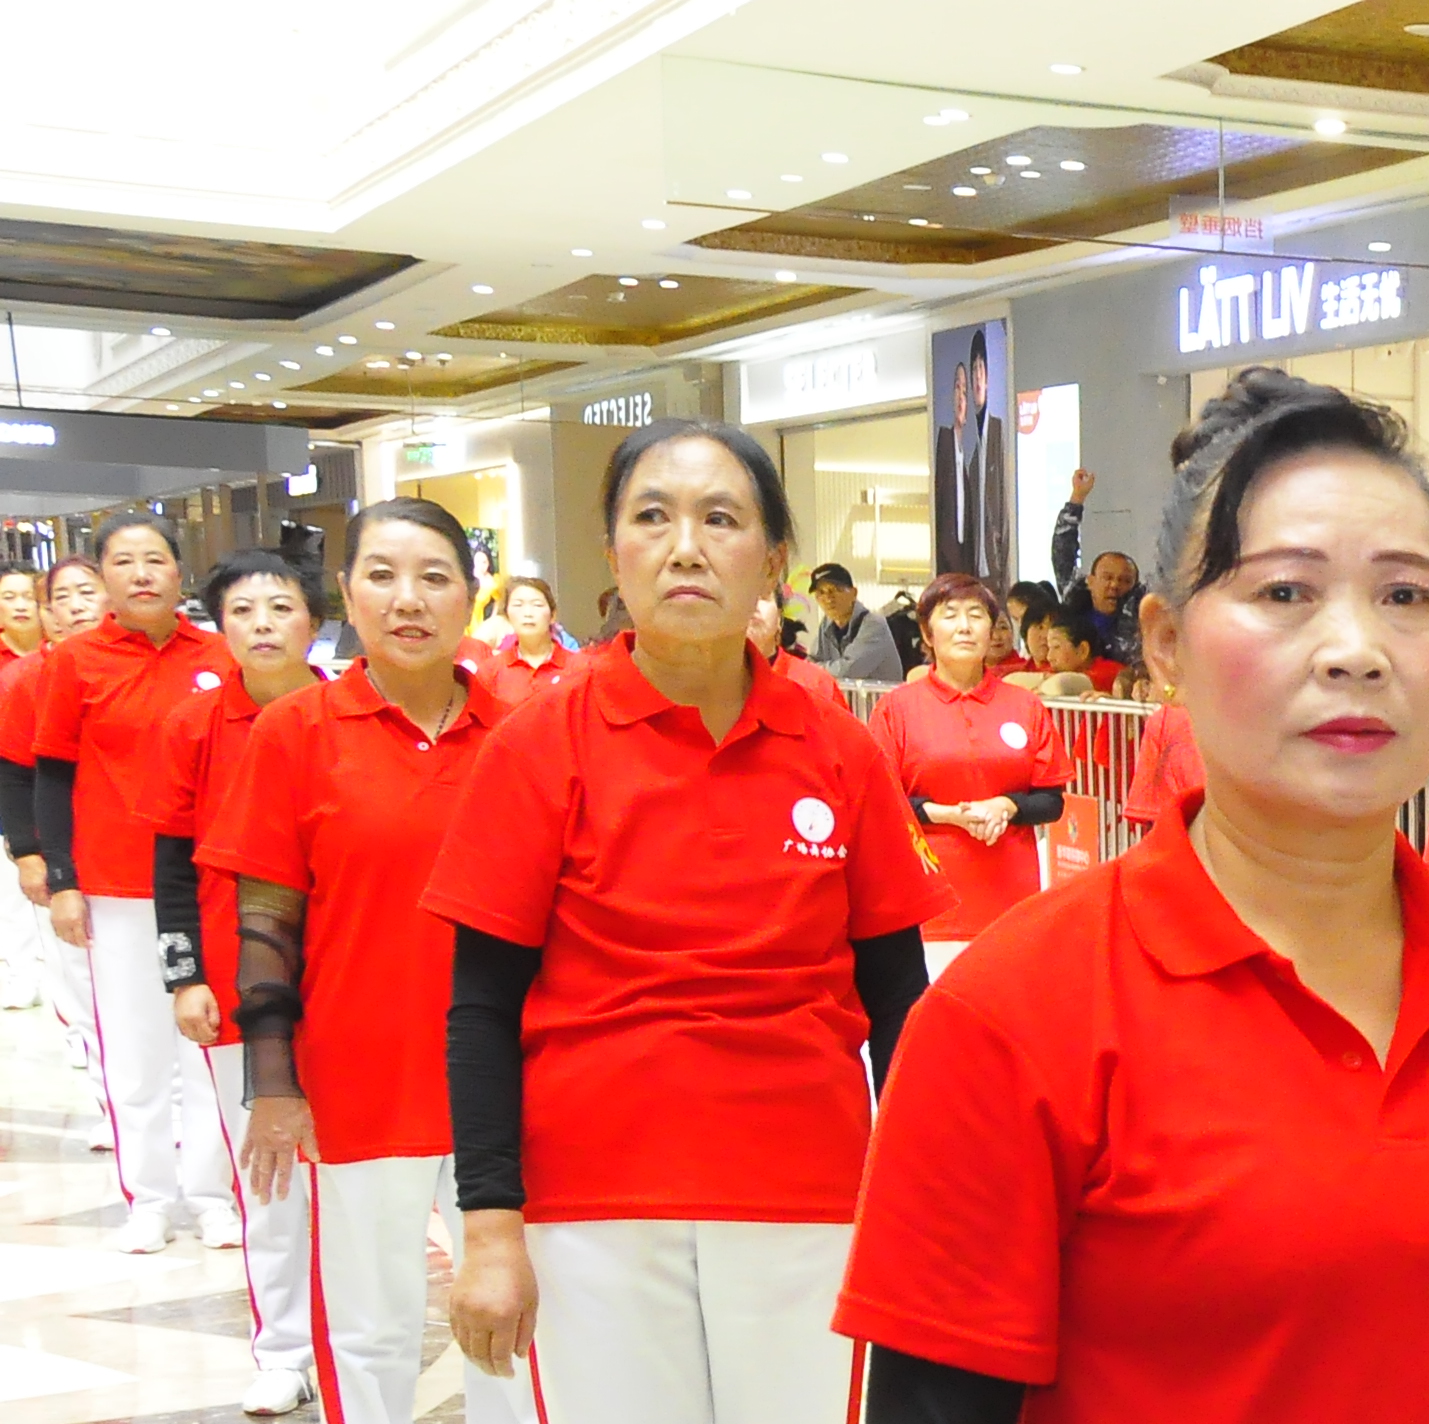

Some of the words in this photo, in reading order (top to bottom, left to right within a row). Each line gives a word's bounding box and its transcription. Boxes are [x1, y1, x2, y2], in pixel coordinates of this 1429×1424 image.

[1179, 264, 1255, 353] LÄTT
[1262, 261, 1315, 339] LIV
[1319, 269, 1401, 330] 生活无忧
